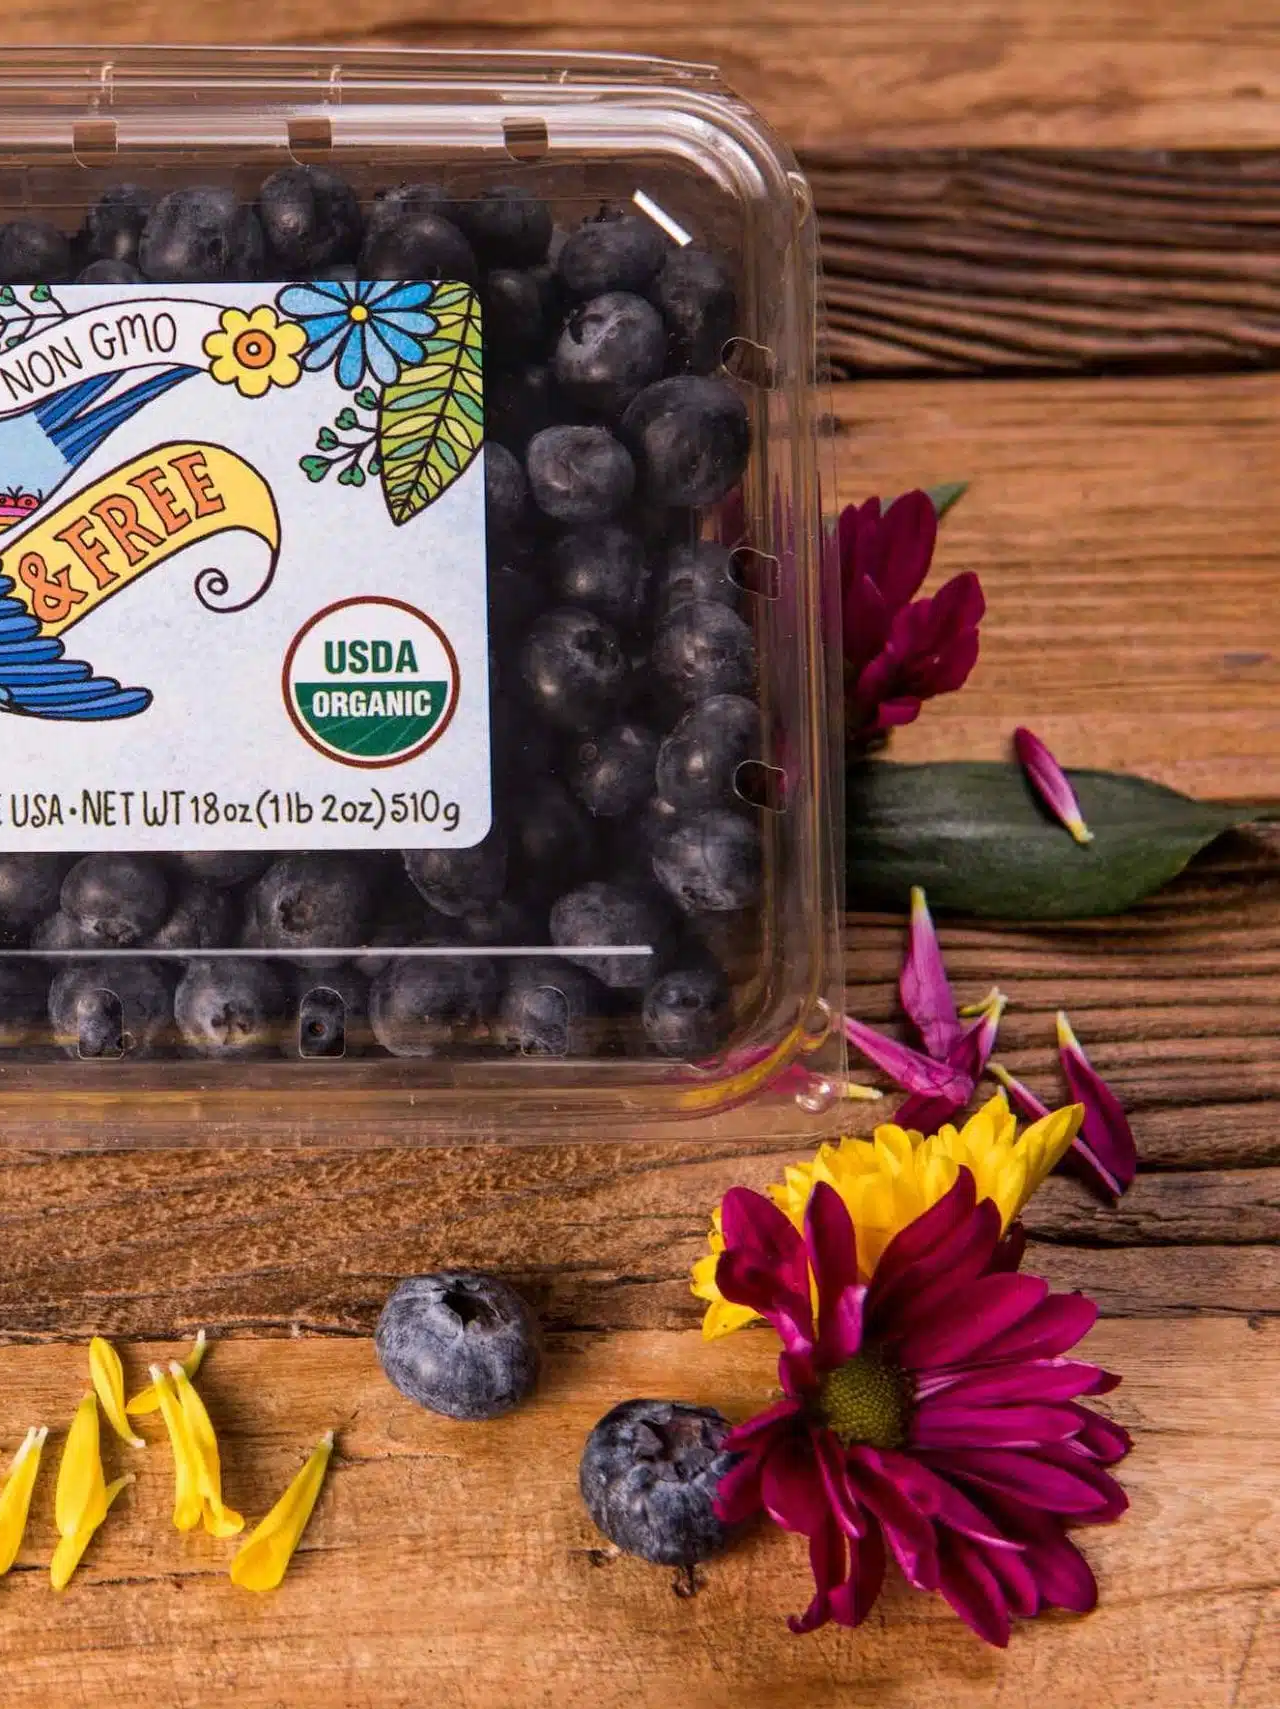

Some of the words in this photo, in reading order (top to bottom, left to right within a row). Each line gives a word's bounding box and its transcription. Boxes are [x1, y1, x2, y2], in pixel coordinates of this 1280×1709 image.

[0, 336, 83, 400] NON
[53, 450, 226, 591] FREE
[19, 551, 88, 623] &
[324, 639, 419, 674] USDA
[312, 690, 432, 718] ORGANIC
[10, 793, 62, 828] USA
[81, 790, 134, 826] NET
[142, 790, 186, 827] WT
